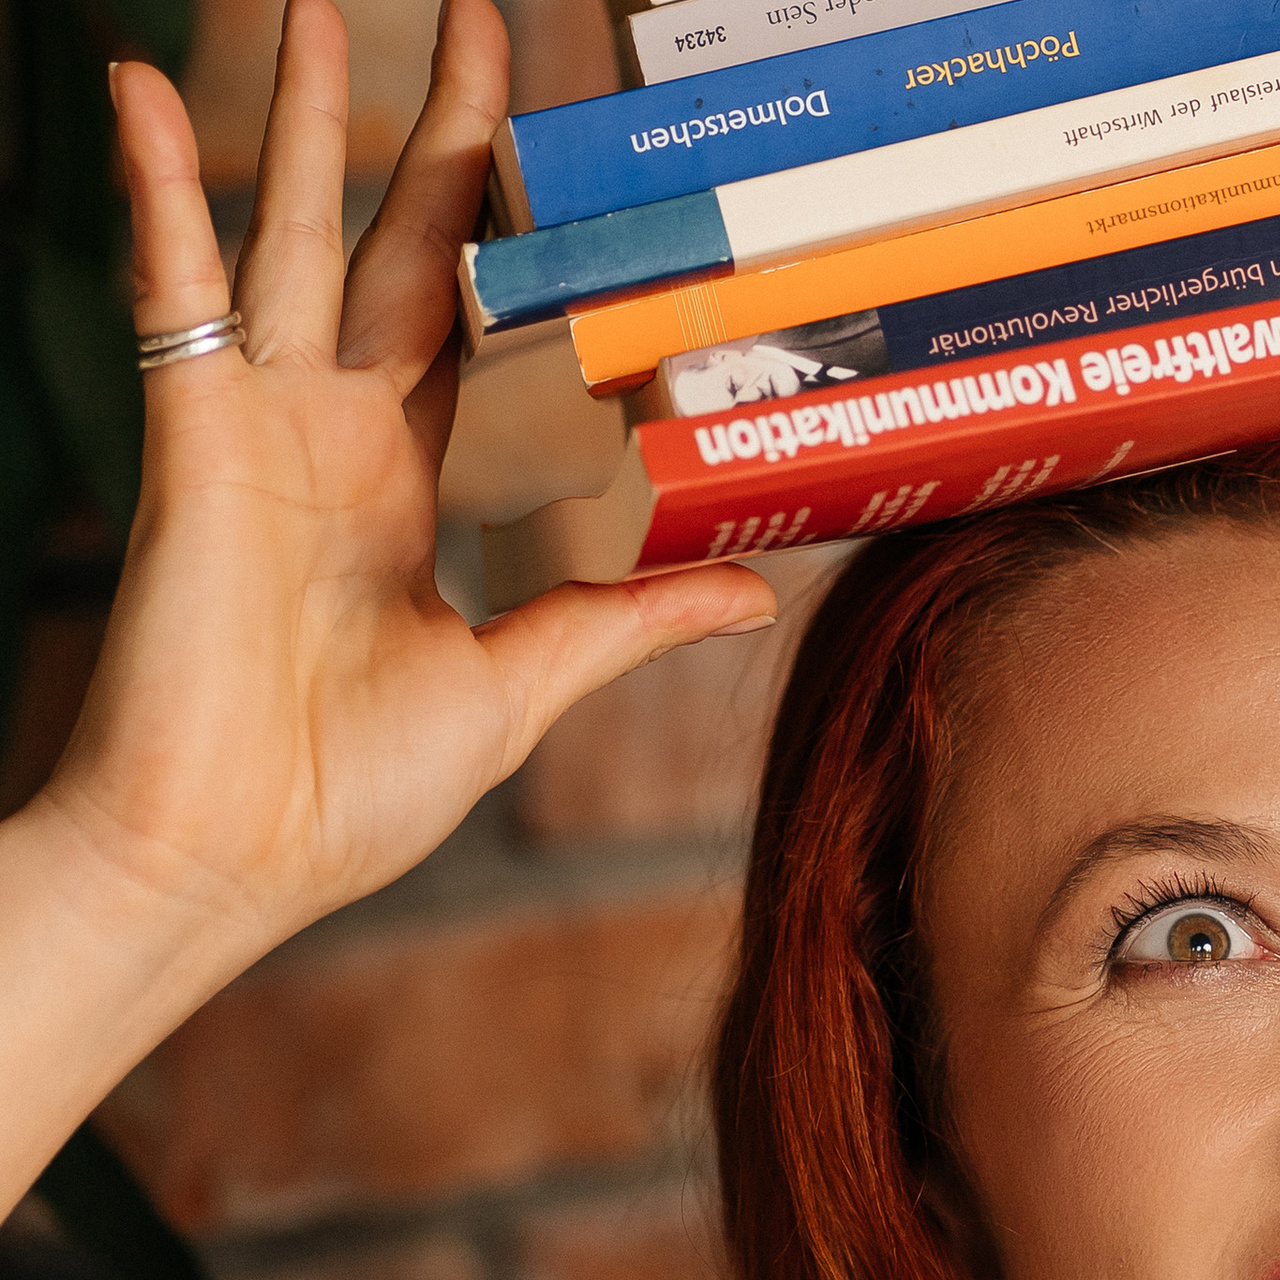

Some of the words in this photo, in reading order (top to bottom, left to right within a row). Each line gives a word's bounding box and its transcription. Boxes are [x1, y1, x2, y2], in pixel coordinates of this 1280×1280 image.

[674, 25, 727, 53] 34234
[766, 2, 819, 30] Sein
[905, 30, 1081, 90] Pöchhacker
[630, 89, 831, 153] Dolmetschen
[1064, 108, 1164, 148] Wirtschaft
[1170, 96, 1202, 120] der
[1105, 260, 1266, 317] bürgerlicher
[928, 299, 1098, 357] Revolutionär
[694, 354, 1078, 467] Kommunikation
